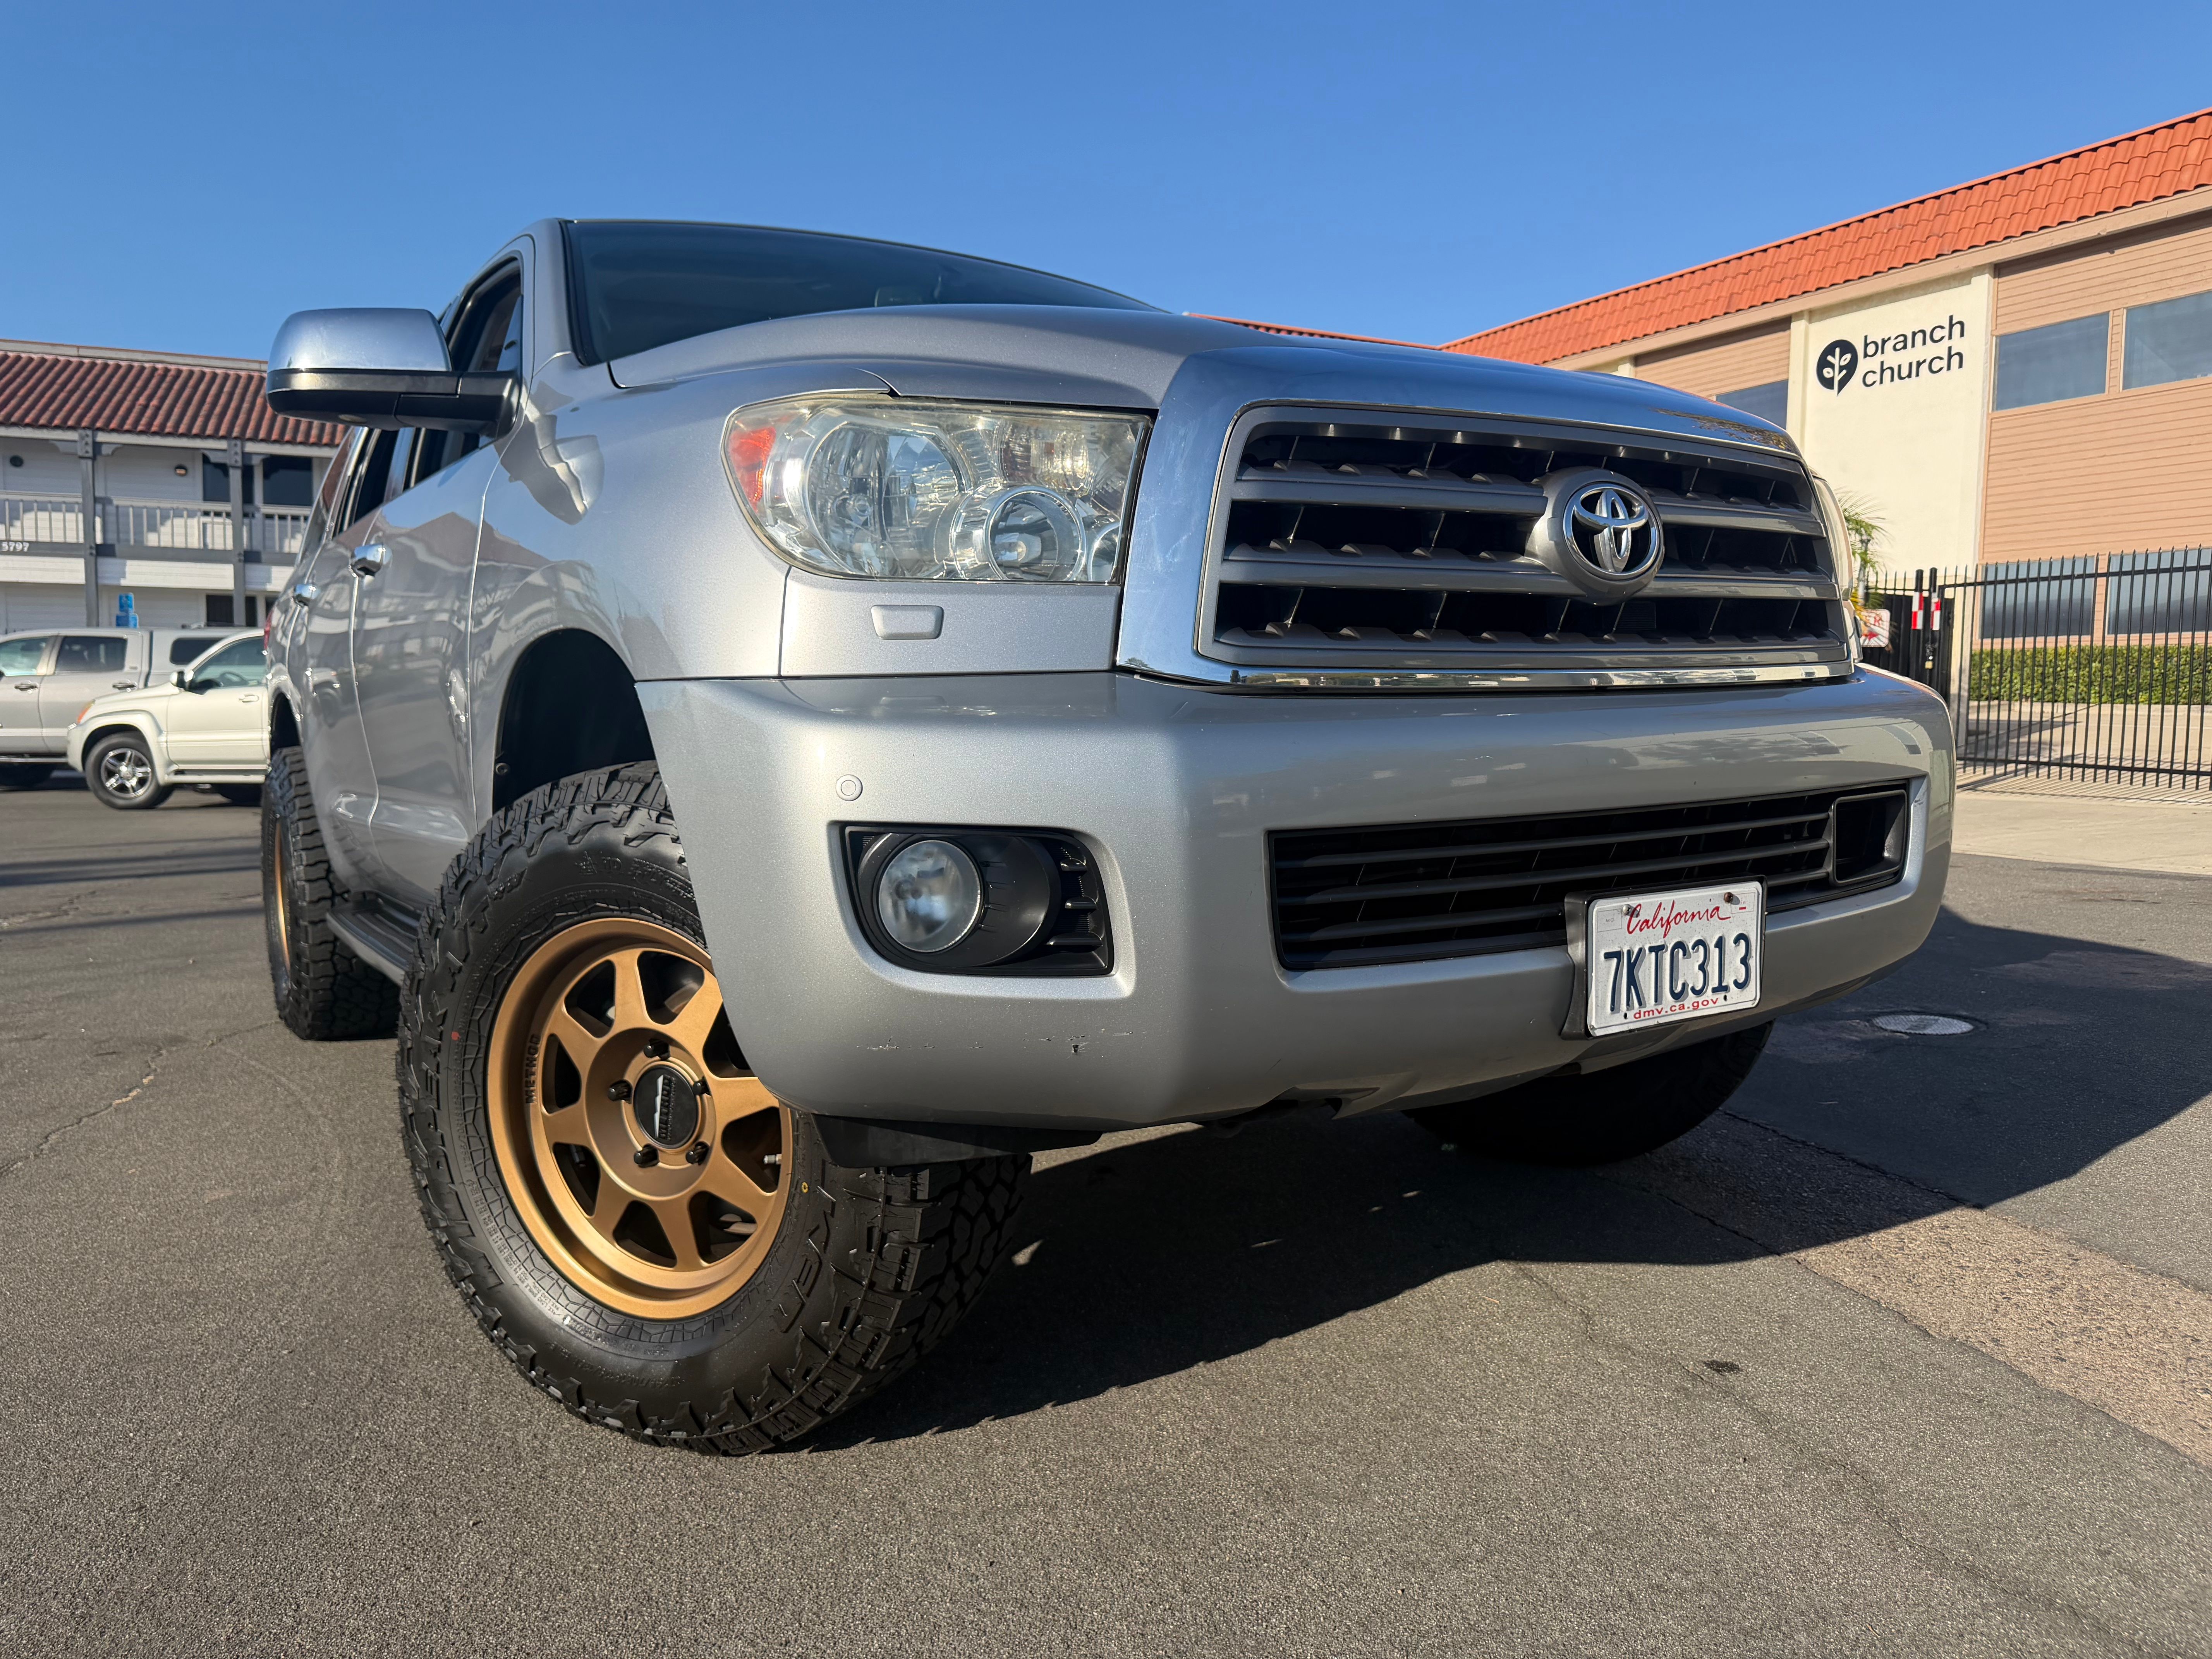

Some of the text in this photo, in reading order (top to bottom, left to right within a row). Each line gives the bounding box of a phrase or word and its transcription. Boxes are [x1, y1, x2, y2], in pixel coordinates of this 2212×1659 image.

[1863, 315, 1965, 359] branch
[1862, 346, 1963, 387] church
[2, 542, 29, 552] 5797
[1626, 900, 1731, 939] California
[1604, 933, 1751, 1012] 7KTC313
[1633, 997, 1719, 1020] dmv.ca.gov
[525, 1034, 541, 1103] METHOD
